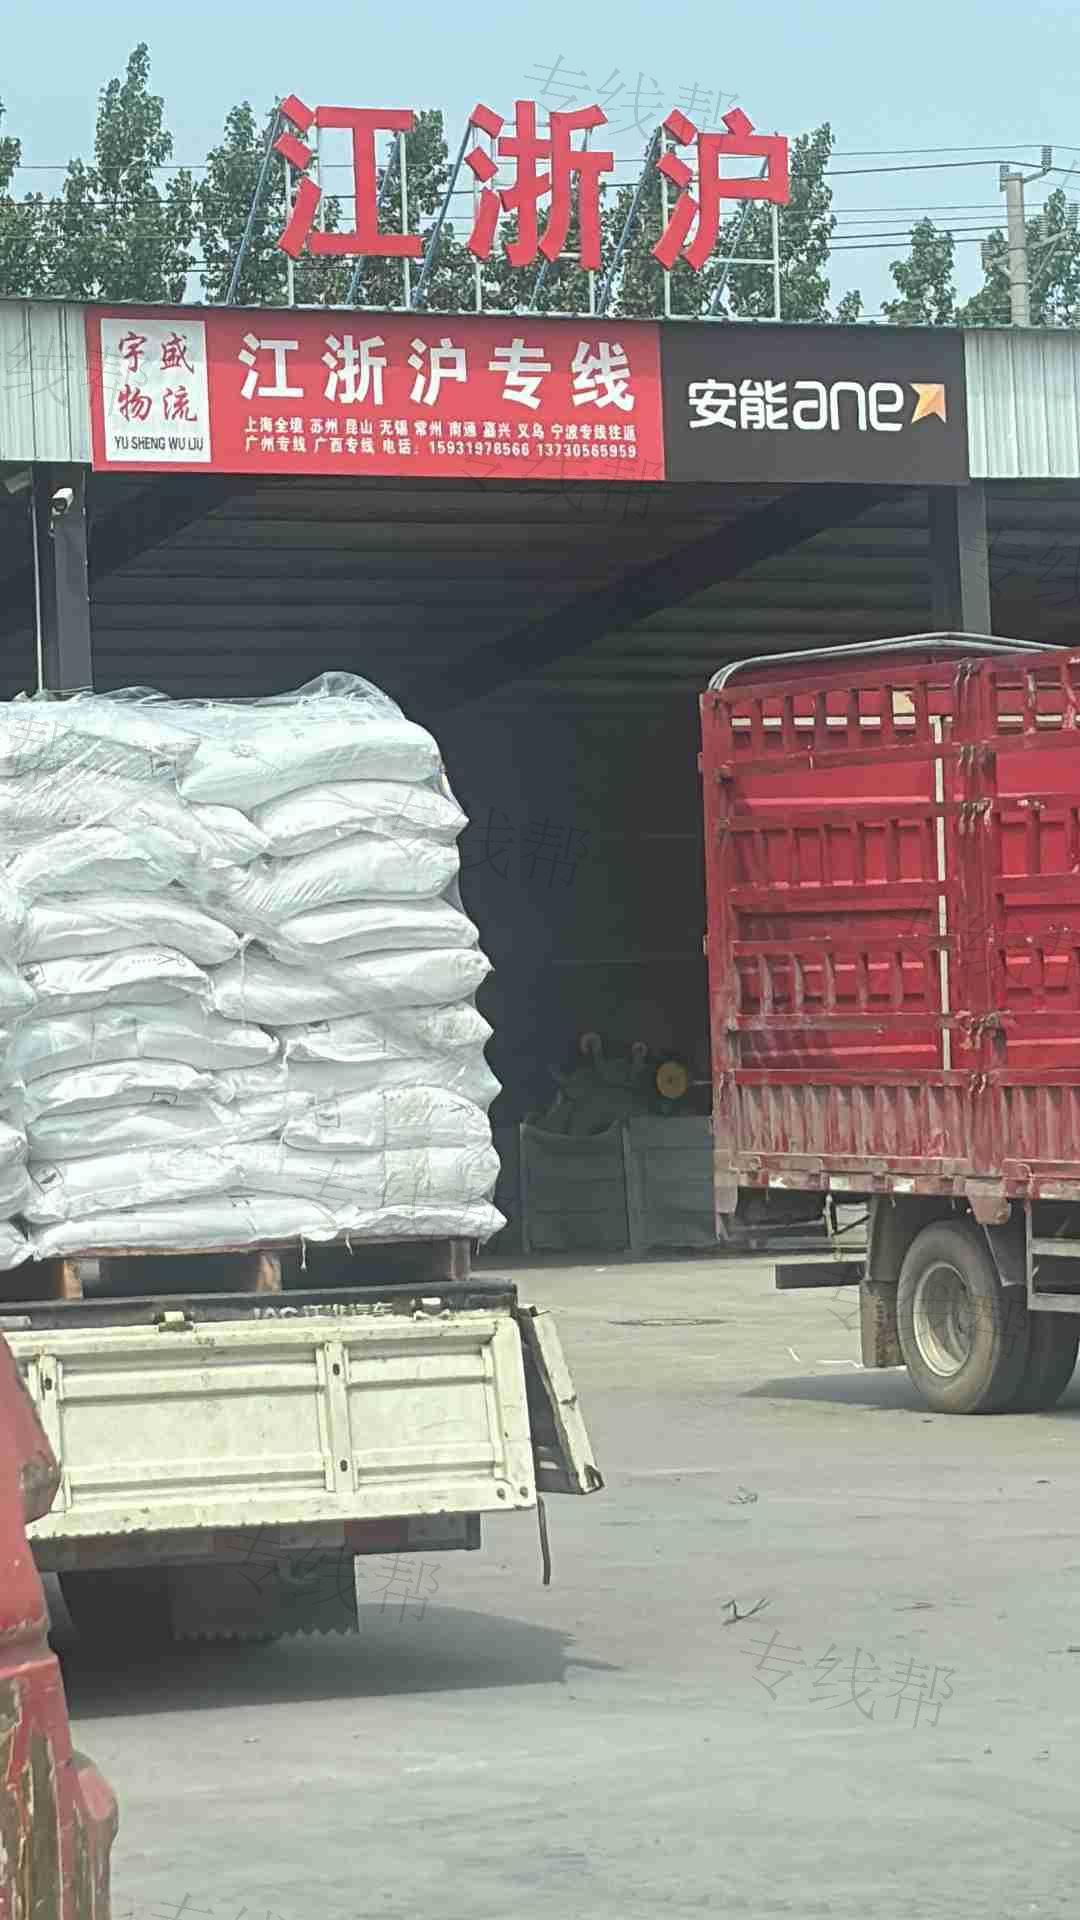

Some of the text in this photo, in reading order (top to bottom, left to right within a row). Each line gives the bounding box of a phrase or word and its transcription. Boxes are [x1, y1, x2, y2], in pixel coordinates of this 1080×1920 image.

[273, 94, 790, 272] 江浙沪
[118, 332, 194, 373] 宇盛
[239, 333, 635, 411] 江浙沪专线
[117, 384, 198, 422] 物流
[114, 436, 204, 451] YU SHENG WU LIU
[245, 416, 303, 433] 上海全境
[310, 418, 338, 434] 苏州
[345, 418, 373, 435] 昆山
[414, 420, 442, 437] 常州
[517, 423, 544, 439] 义乌
[245, 435, 306, 453] 广州专线
[313, 437, 375, 454] 广西专线
